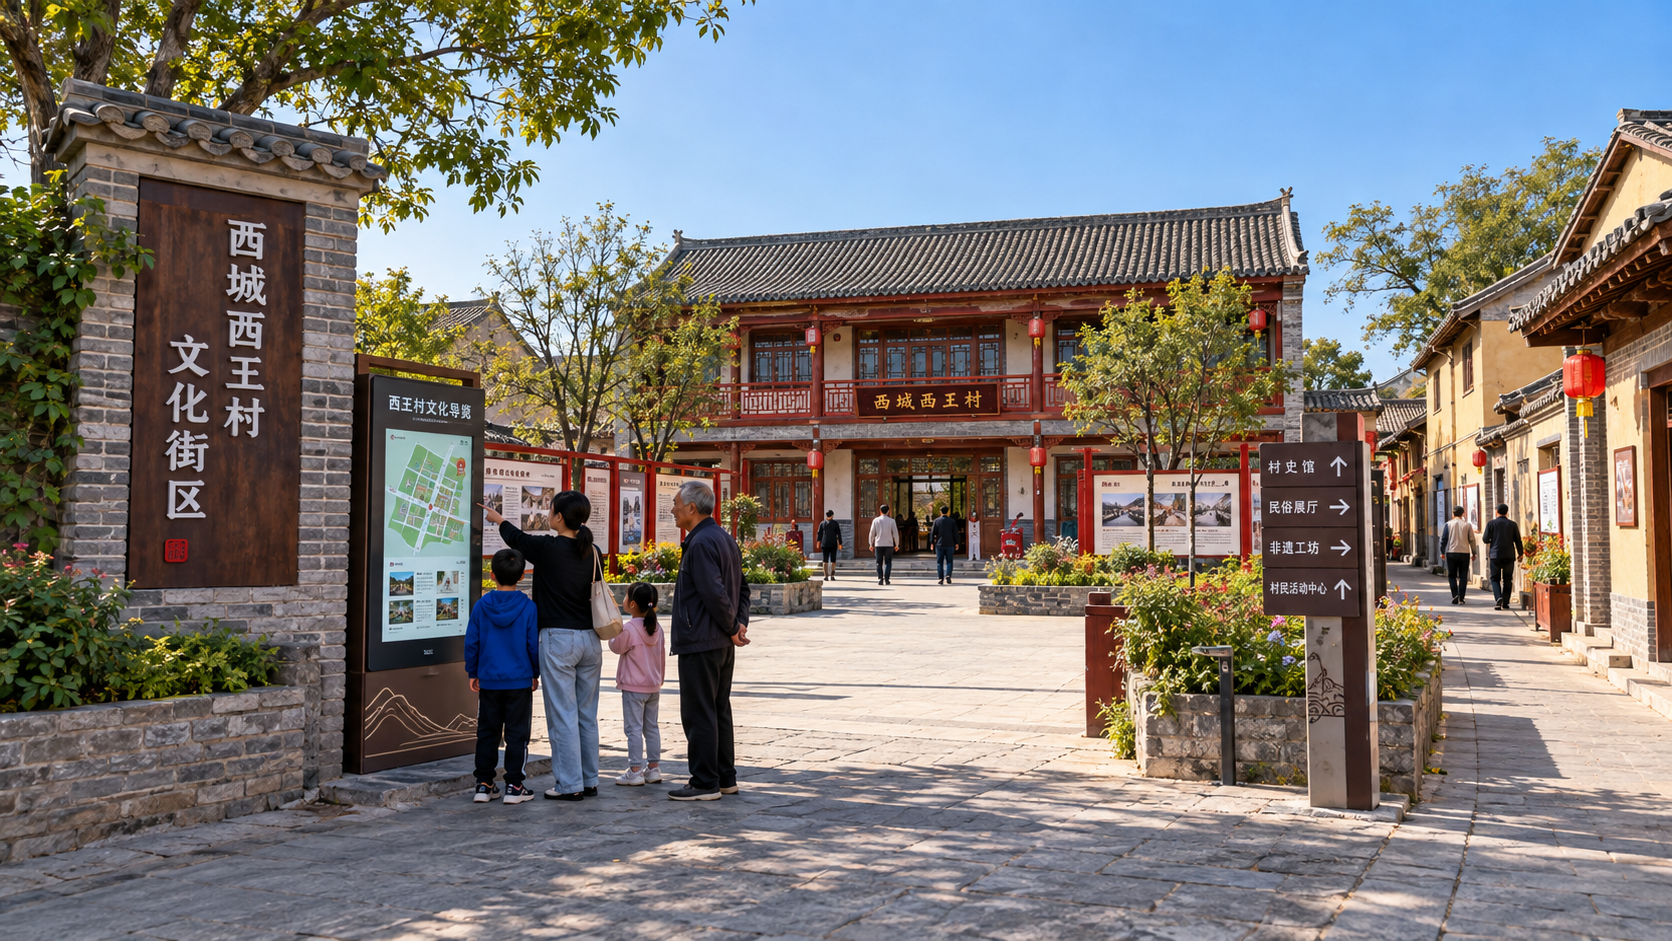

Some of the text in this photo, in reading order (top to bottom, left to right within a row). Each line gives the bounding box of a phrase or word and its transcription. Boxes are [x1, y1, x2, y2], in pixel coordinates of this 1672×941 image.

[224, 218, 267, 437] 西城西王村
[873, 390, 982, 410] 西城西王村
[165, 334, 210, 519] 文化街区
[1268, 460, 1315, 474] 村史馆
[1269, 501, 1318, 514] 民俗展厅
[1269, 541, 1320, 555] 非遗工坊
[1269, 581, 1328, 595] 村民活动中心
